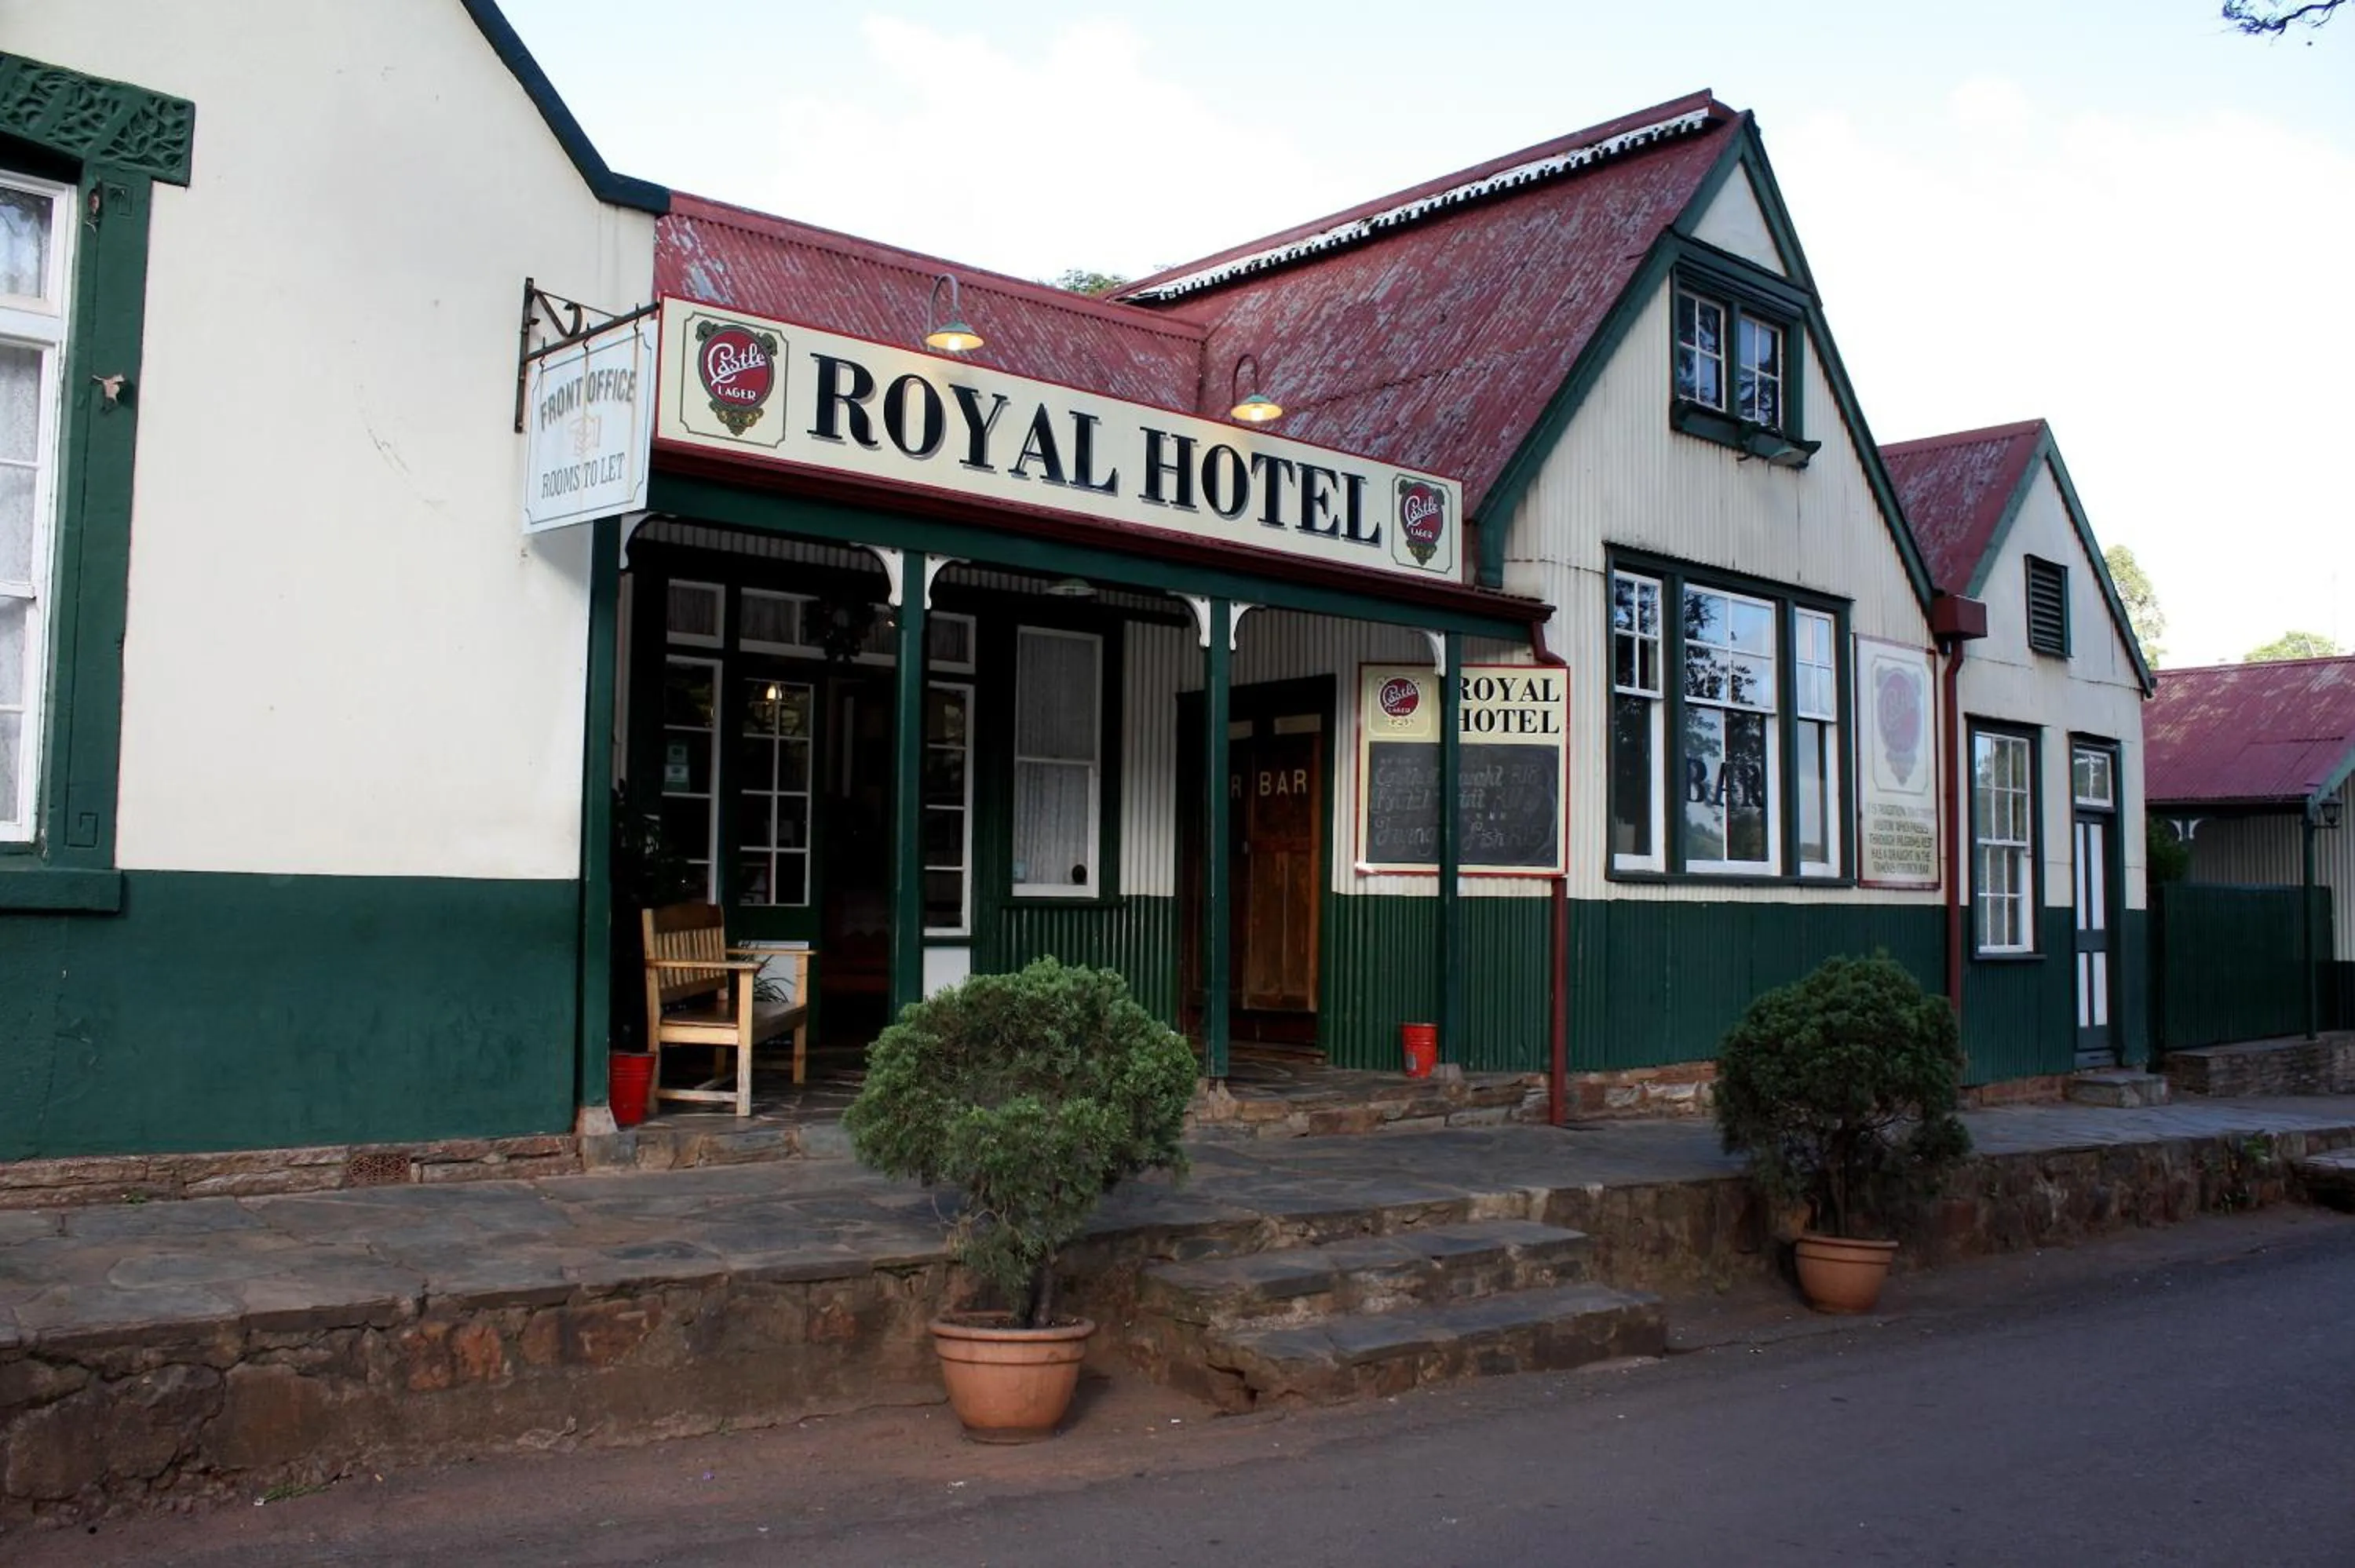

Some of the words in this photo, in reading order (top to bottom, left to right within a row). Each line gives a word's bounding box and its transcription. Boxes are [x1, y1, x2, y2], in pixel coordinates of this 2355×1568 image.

[708, 343, 766, 386] Castle
[540, 376, 583, 431] FRONT
[586, 368, 637, 404] OFFICE
[718, 385, 756, 400] LAGER
[807, 352, 1118, 496] ROYAL
[1137, 425, 1382, 547] HOTEL
[542, 464, 581, 499] ROOMS
[583, 460, 597, 488] TO
[600, 452, 626, 484] LET
[1405, 495, 1438, 528] Castle
[1459, 676, 1561, 702] ROYAL
[1459, 709, 1560, 734] HOTEL
[1259, 768, 1307, 797] BAR
[1685, 758, 1765, 807] BAR
